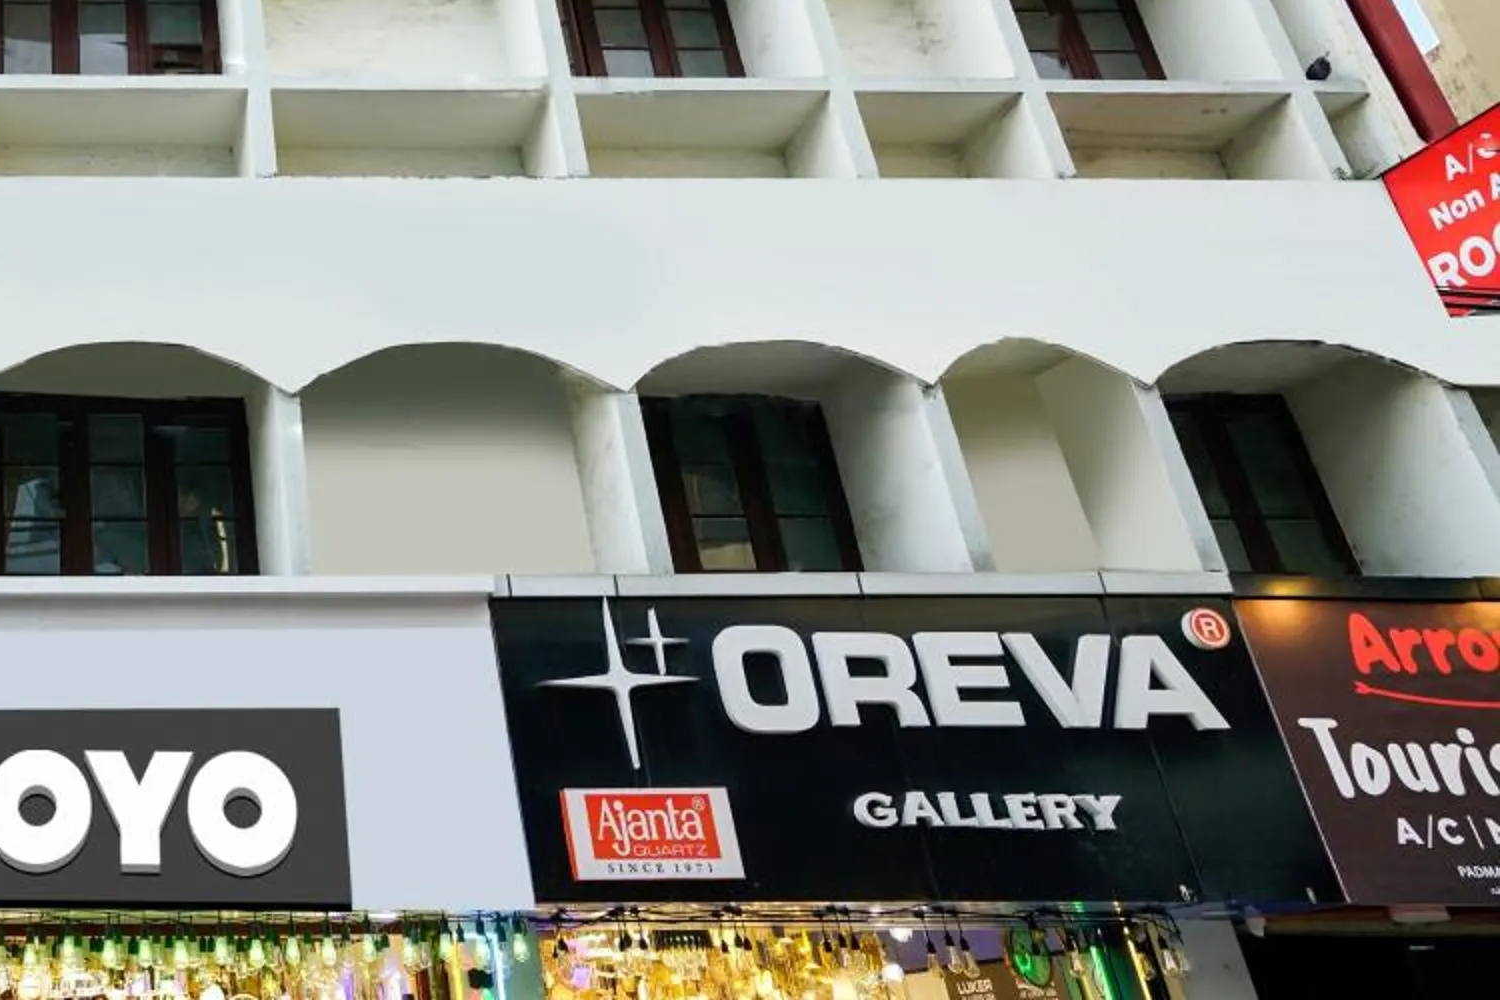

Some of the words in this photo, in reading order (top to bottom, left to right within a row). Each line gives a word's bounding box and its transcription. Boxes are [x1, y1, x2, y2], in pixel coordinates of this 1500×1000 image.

[1428, 188, 1485, 231] Non
[1427, 221, 1500, 288] RO
[1348, 612, 1500, 675] Arro
[711, 624, 1231, 734] OREVA
[597, 797, 706, 857] Ajanta
[853, 790, 1123, 831] GALLERY
[607, 862, 665, 873] SINCE
[674, 862, 714, 873] 1971
[633, 844, 709, 857] QUARTZ
